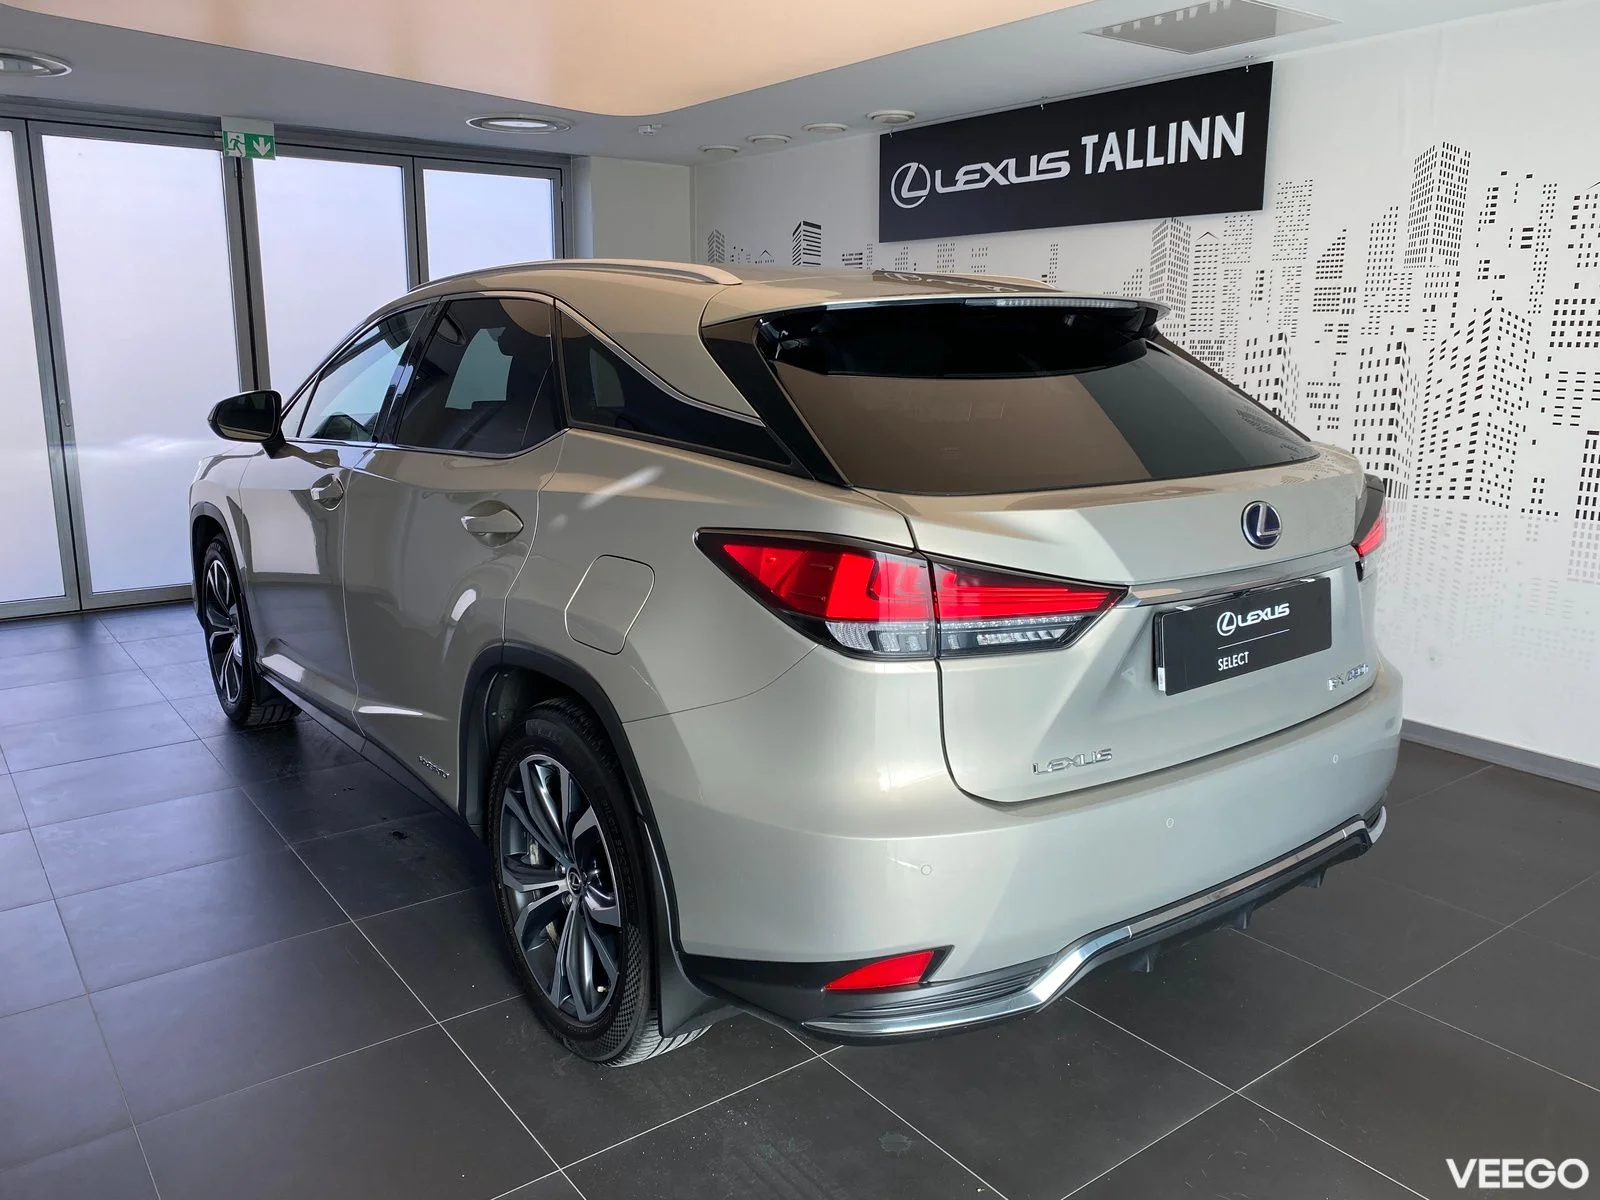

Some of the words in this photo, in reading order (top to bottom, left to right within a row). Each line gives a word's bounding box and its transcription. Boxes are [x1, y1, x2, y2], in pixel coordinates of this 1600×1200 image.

[935, 150, 1070, 194] LEXUS
[1081, 111, 1246, 175] TALLINN
[1237, 603, 1290, 627] LEXUS
[1217, 651, 1250, 672] SELECT
[1032, 748, 1112, 775] LEXUS
